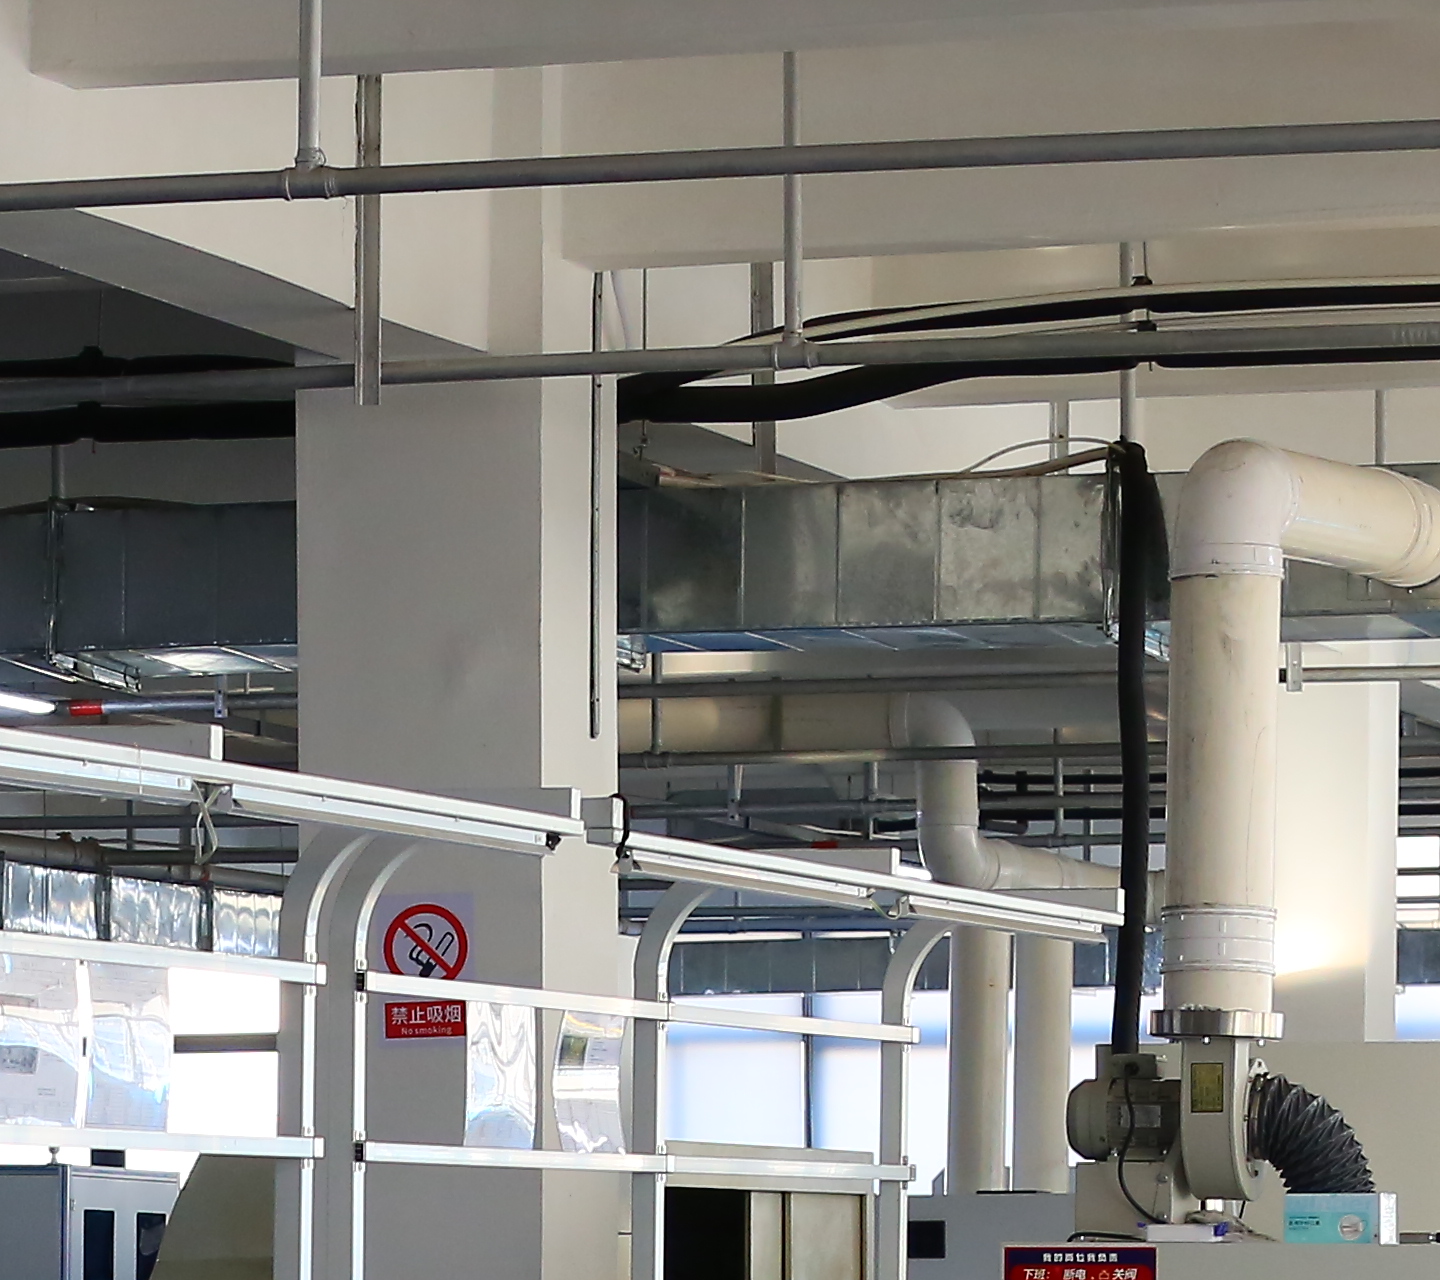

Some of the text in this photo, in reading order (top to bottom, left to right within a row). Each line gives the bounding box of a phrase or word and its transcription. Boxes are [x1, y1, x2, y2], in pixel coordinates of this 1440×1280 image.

[391, 1004, 462, 1025] 禁止吸烟
[401, 1025, 453, 1036] No smoking
